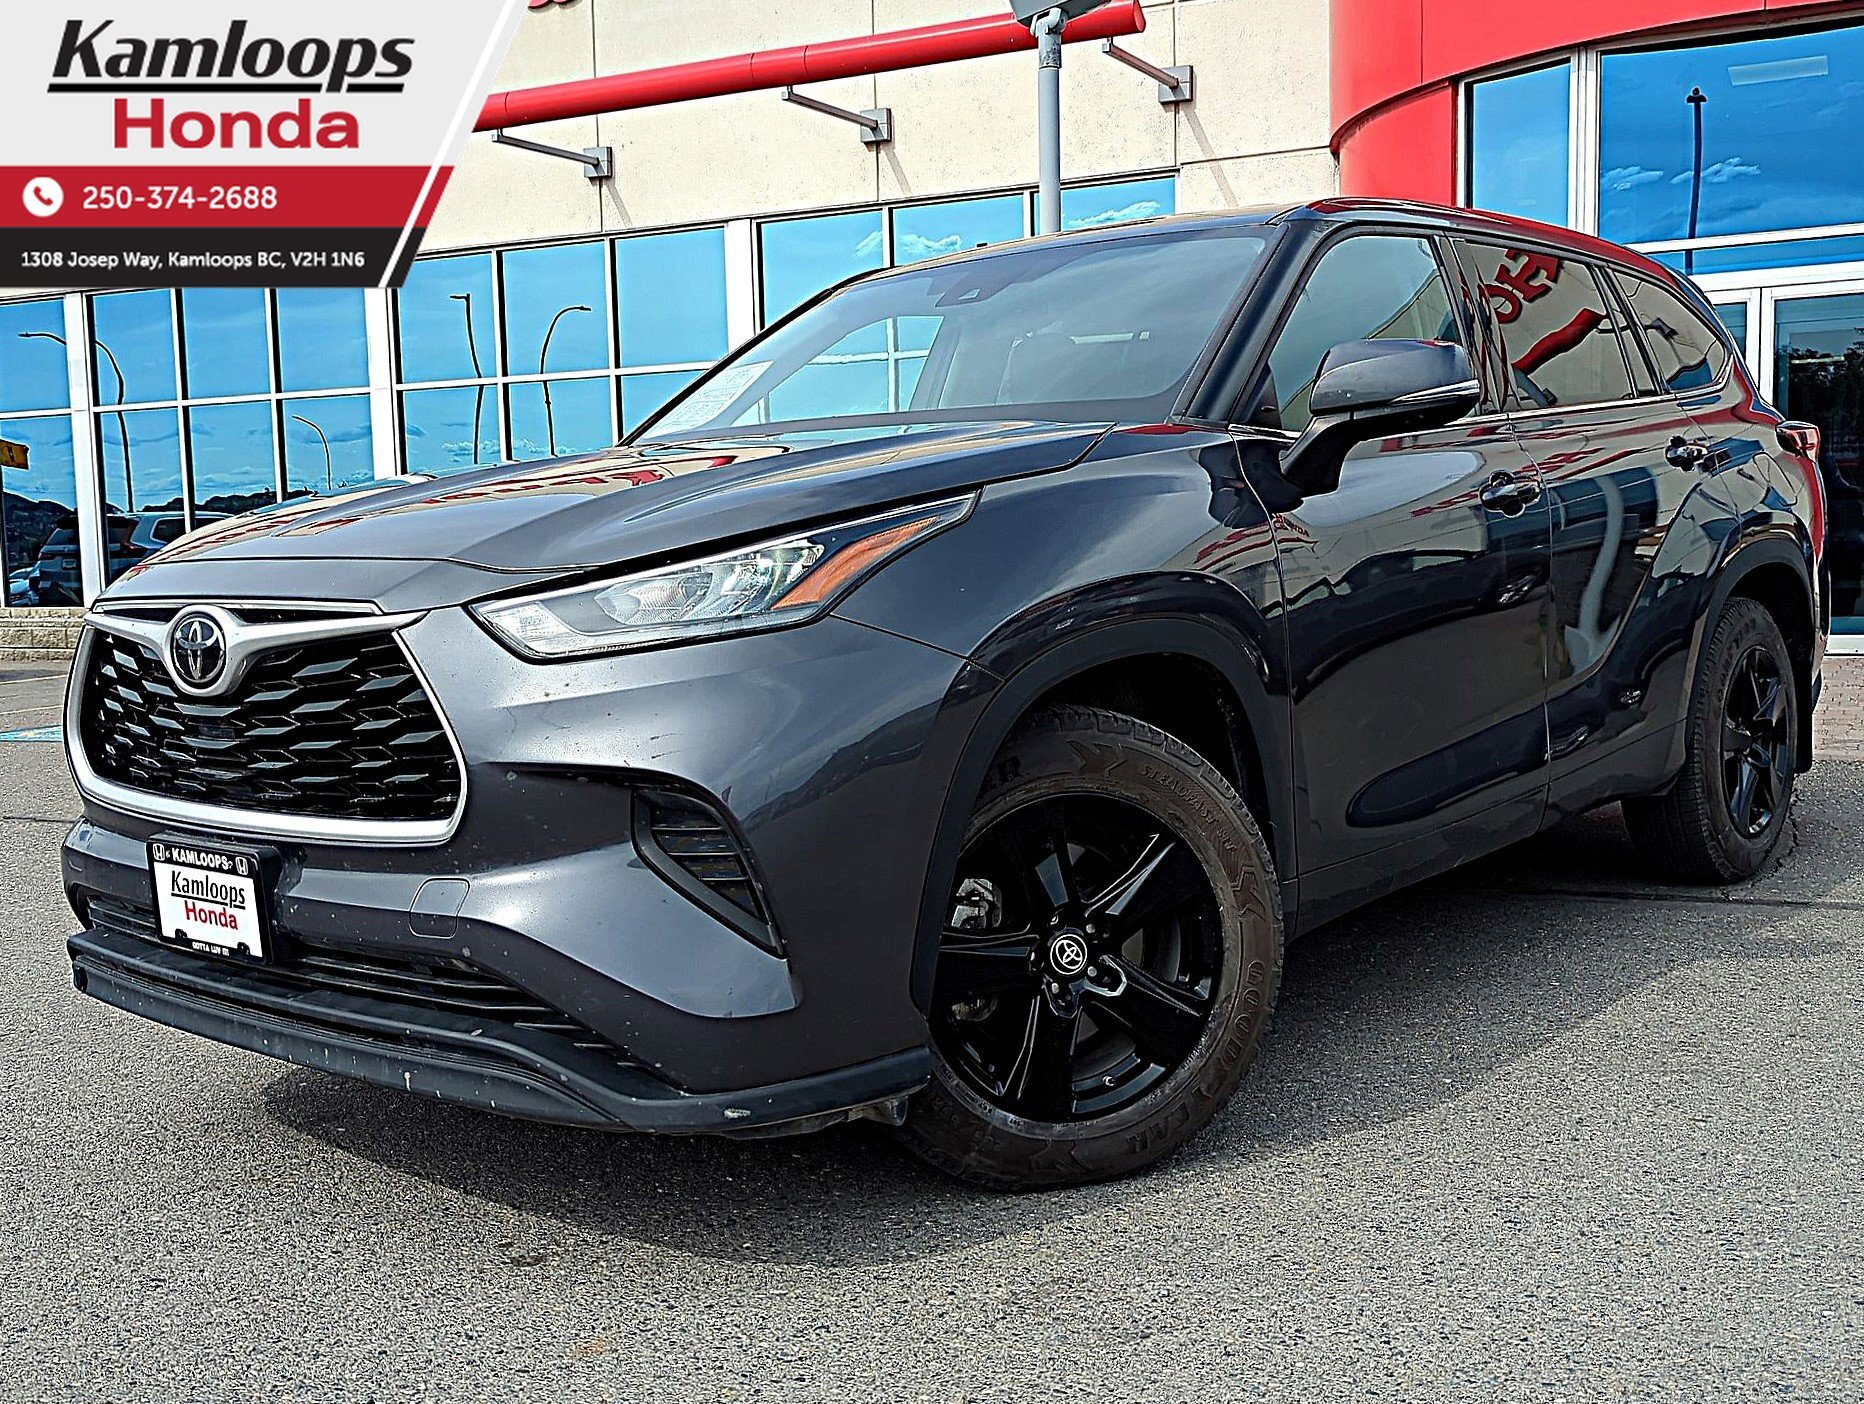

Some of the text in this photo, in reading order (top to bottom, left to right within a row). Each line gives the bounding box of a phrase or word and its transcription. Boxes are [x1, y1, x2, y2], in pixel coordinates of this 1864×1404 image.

[171, 847, 229, 870] KAMLOOPS
[171, 870, 245, 908] Kamloops
[184, 900, 238, 930] Honda
